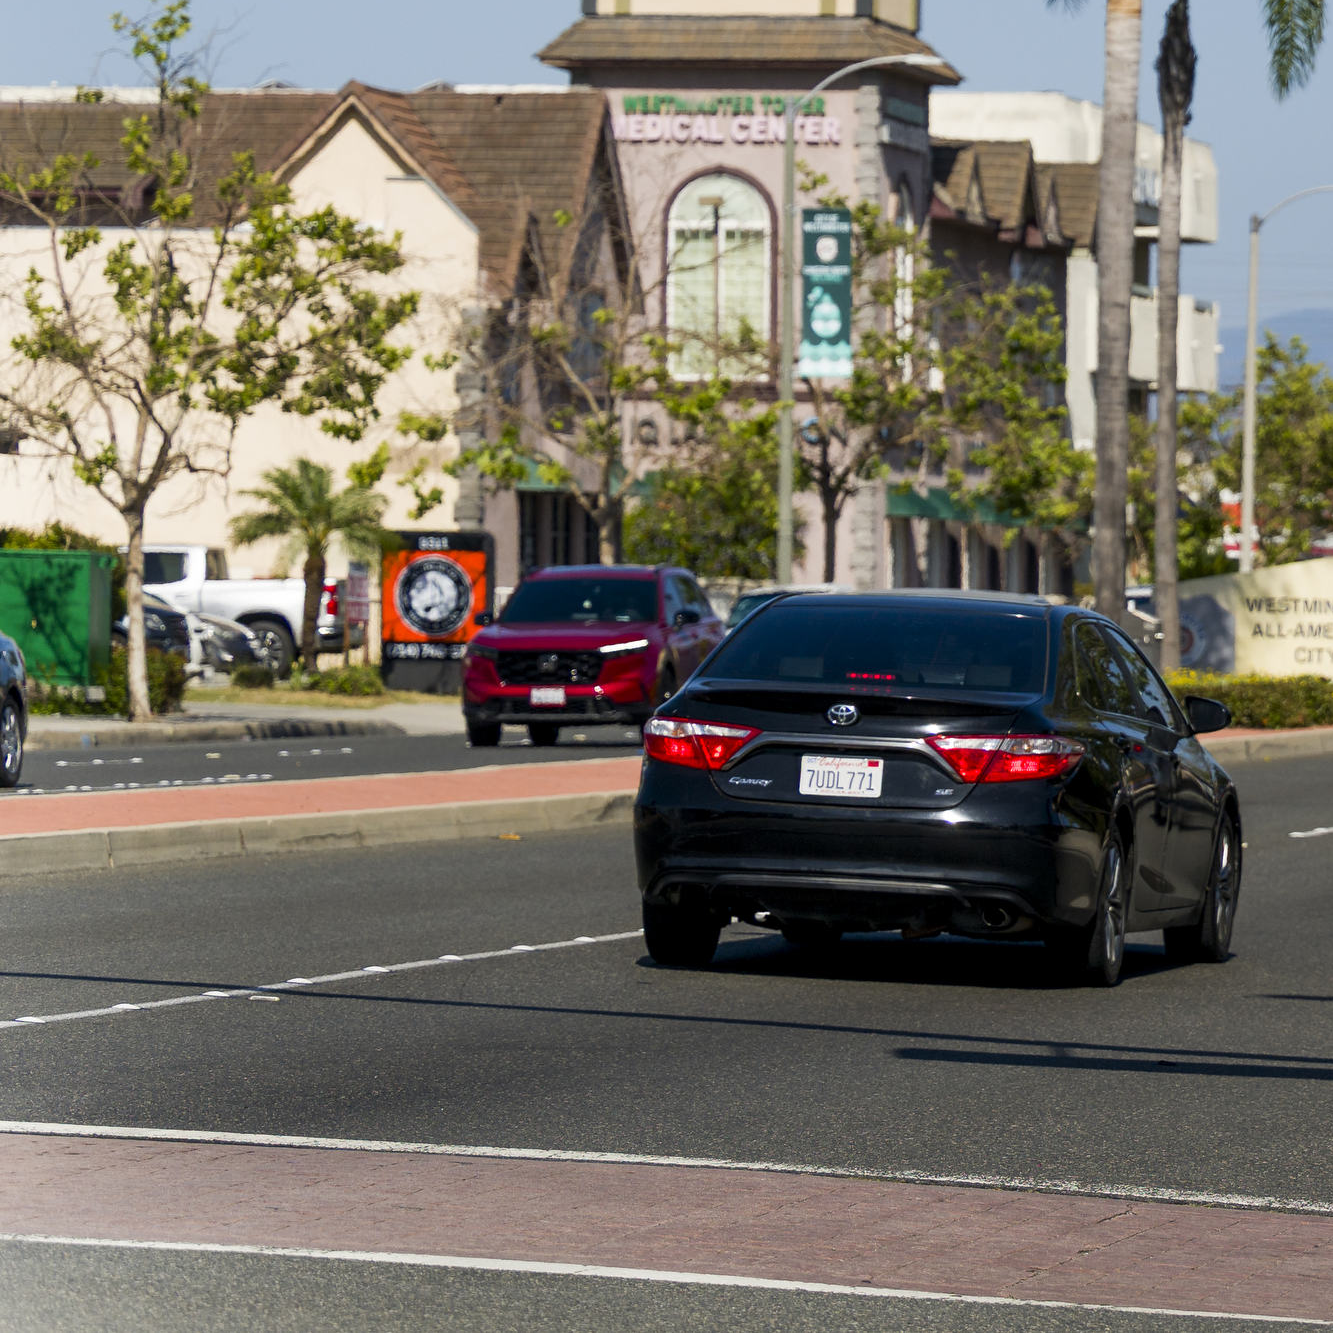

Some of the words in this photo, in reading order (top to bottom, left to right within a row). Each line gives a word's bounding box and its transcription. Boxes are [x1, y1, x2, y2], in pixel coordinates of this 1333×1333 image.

[759, 96, 826, 117] TOER
[729, 776, 773, 787] Camry
[807, 769, 875, 791] 7UDL771
